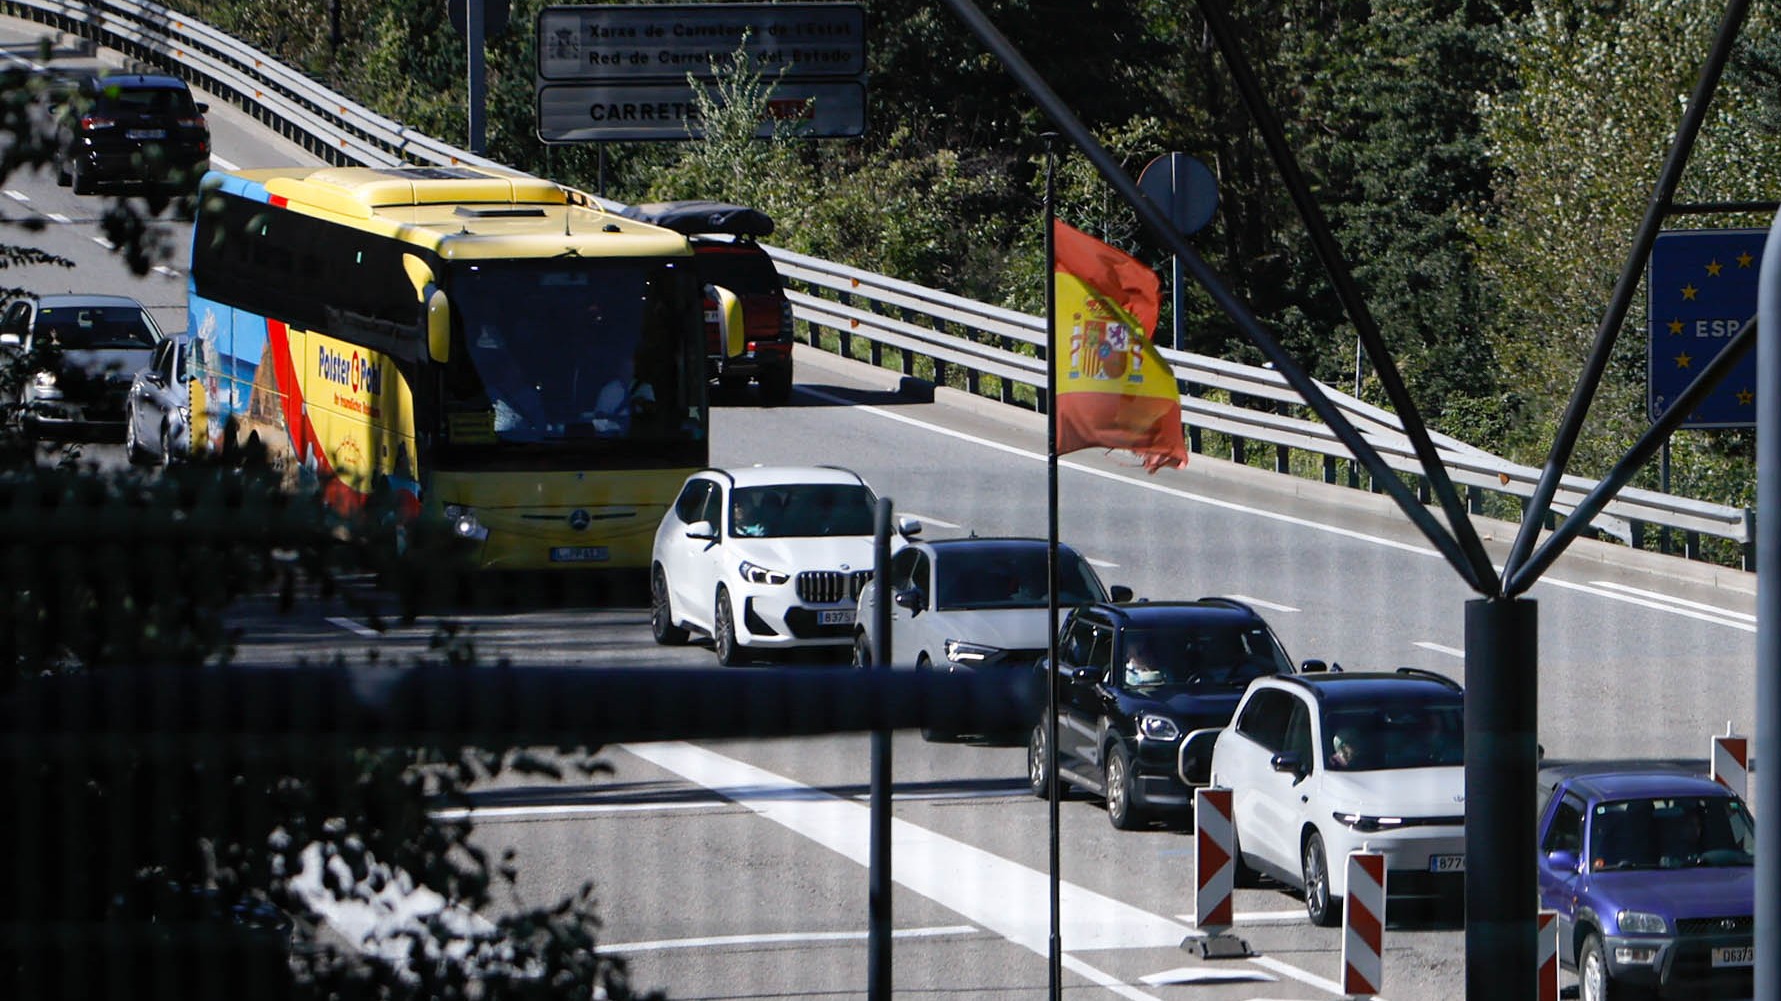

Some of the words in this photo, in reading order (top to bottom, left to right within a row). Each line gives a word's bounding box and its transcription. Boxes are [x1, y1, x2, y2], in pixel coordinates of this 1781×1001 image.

[590, 24, 636, 38] Xarxa
[646, 23, 665, 37] de
[768, 22, 786, 36] de
[589, 50, 621, 64] Red
[630, 50, 649, 64] de
[794, 48, 850, 63] Estado
[590, 103, 704, 121] CARRETE
[318, 345, 350, 386] Polster
[360, 357, 382, 396] Pohl
[1439, 857, 1465, 870] 877
